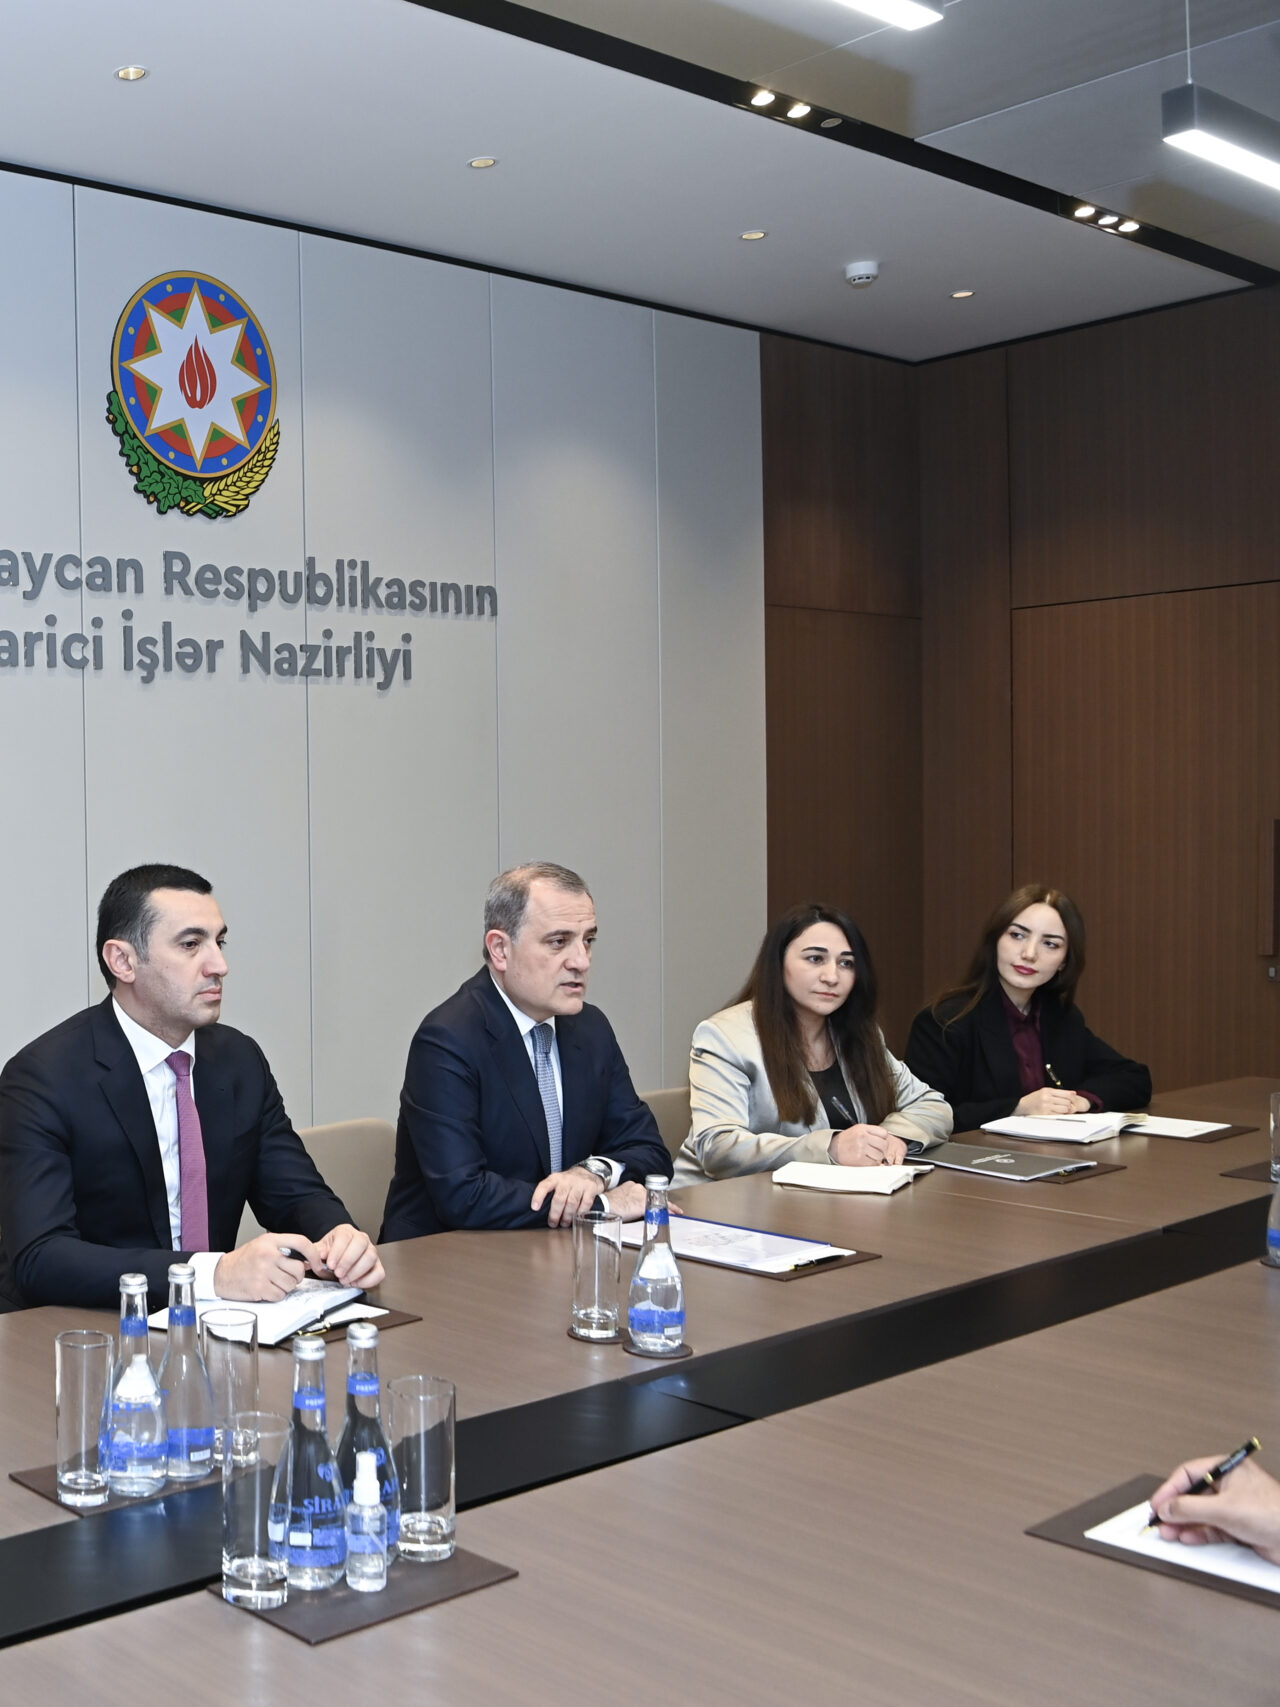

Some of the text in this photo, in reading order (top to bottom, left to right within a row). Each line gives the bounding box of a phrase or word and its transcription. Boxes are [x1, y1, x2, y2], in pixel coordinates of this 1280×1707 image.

[162, 550, 499, 618] Respublikasının
[121, 608, 224, 685] İşlər
[240, 628, 413, 691] Nazirliyi
